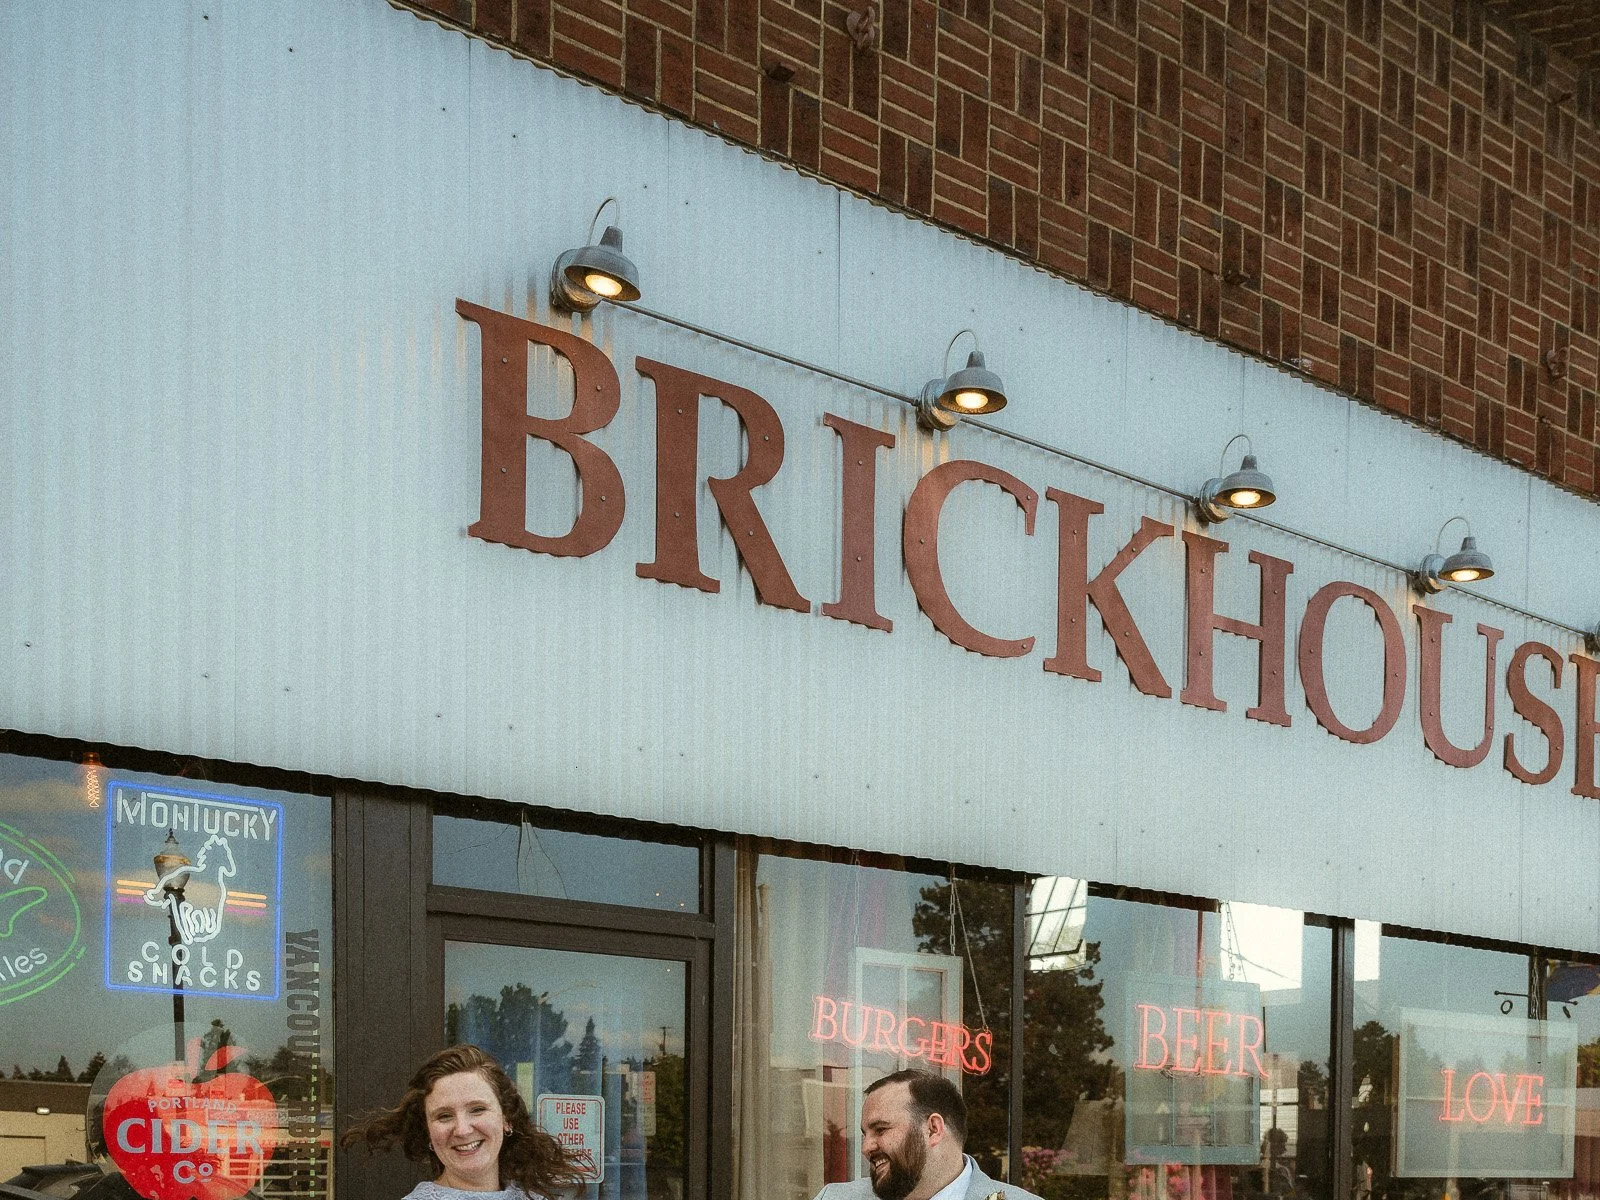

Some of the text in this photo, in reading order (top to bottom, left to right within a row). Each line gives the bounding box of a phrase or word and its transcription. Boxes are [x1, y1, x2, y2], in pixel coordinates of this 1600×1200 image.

[117, 789, 277, 841] MONTUCKY
[141, 941, 244, 970] COLD
[127, 960, 261, 991] SNACKS
[812, 995, 992, 1073] BURGERS
[1135, 1003, 1270, 1079] BEER
[147, 1097, 237, 1114] PORTLAND
[556, 1102, 586, 1115] PLEASE
[1438, 1068, 1544, 1125] LOVE
[116, 1117, 264, 1155] CIDER
[563, 1117, 579, 1130] USE
[558, 1133, 584, 1146] OTHER
